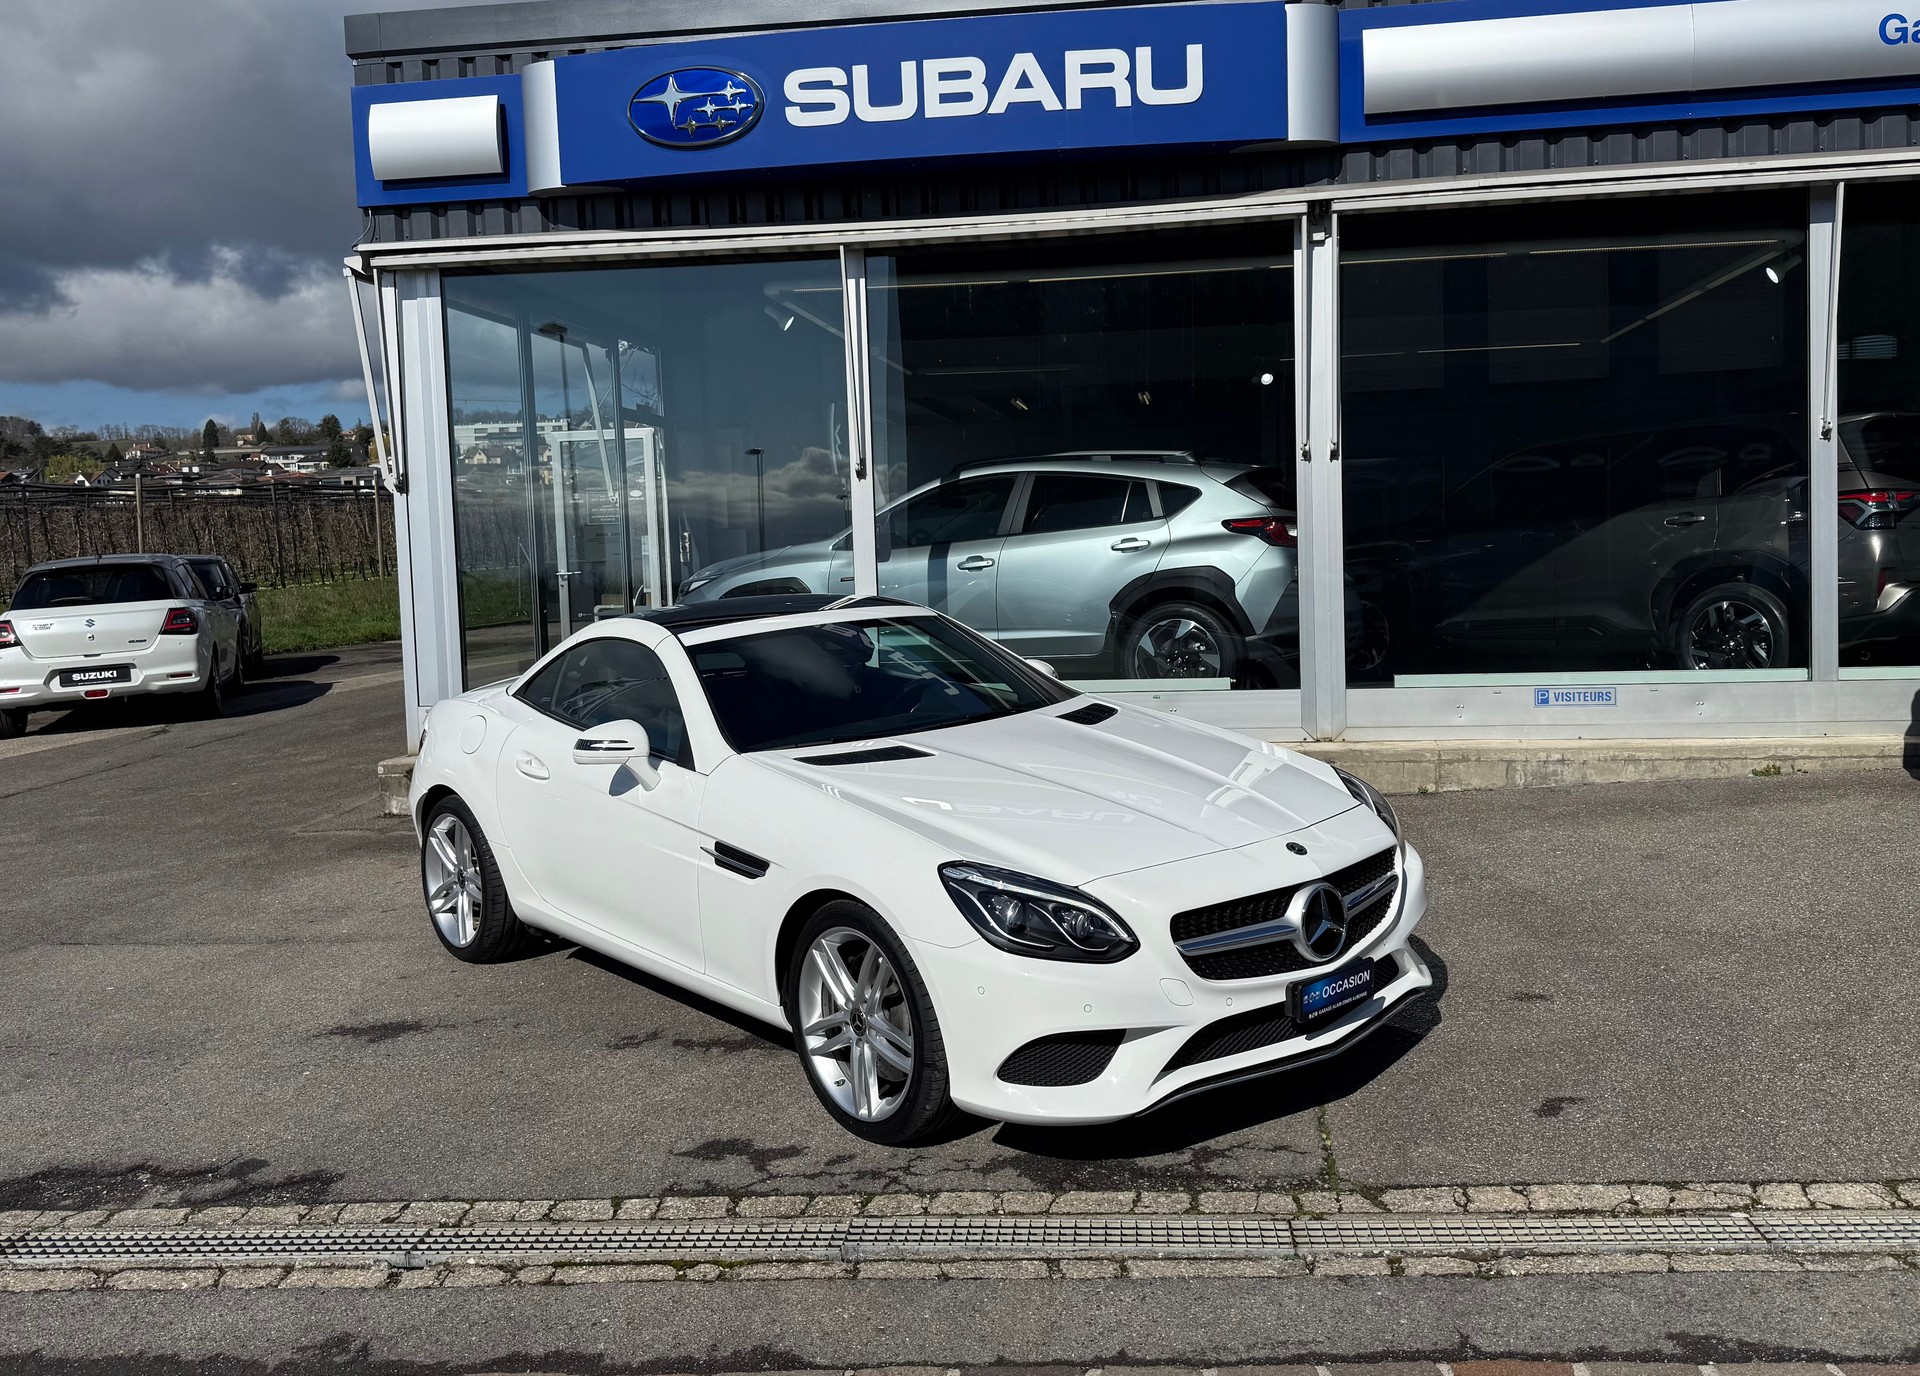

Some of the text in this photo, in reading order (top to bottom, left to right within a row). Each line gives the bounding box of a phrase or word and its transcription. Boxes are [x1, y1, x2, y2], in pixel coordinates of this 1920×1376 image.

[783, 44, 1203, 127] SUBARU
[72, 670, 117, 681] SUZUKI
[1538, 691, 1612, 703] P VISITEURS
[1322, 969, 1370, 998] OCCASION
